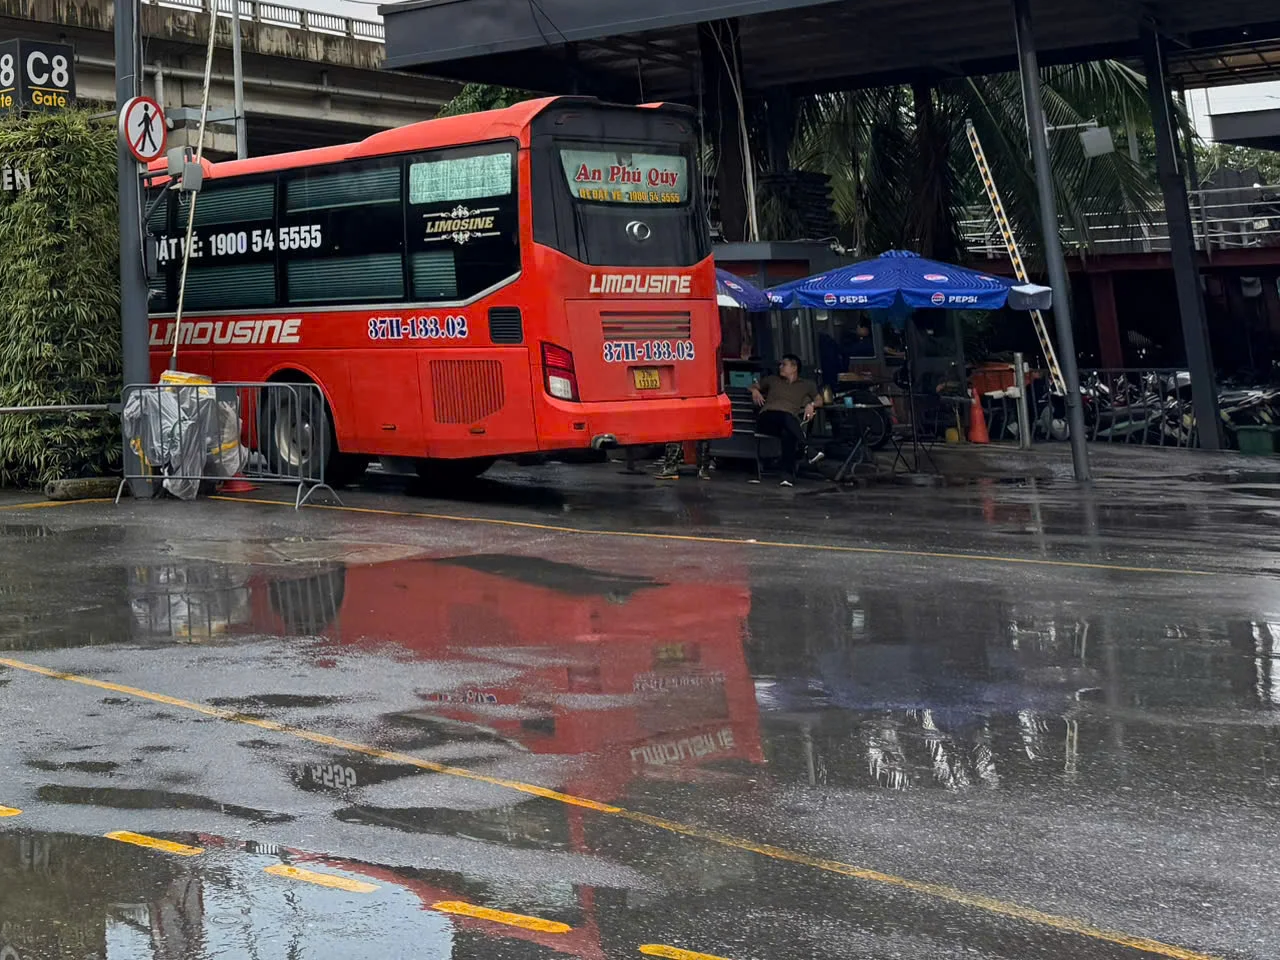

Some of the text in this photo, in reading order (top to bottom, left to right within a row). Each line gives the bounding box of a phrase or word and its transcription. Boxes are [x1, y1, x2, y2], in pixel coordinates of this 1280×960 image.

[26, 50, 70, 88] C8
[31, 90, 67, 108] Gate
[575, 163, 603, 182] An
[608, 165, 642, 183] Phú
[425, 216, 495, 233] LIMOSINE
[155, 235, 178, 265] ẶT
[209, 232, 247, 256] 1900
[252, 228, 275, 253] 54
[279, 224, 322, 251] 5555
[589, 274, 692, 294] LIMOUSINE
[839, 295, 868, 303] PEPSI
[948, 295, 978, 303] PEPSI
[149, 319, 302, 345] LIMOUSINE
[367, 315, 468, 340] 37H-133.02
[603, 340, 695, 362] 37H-133.02
